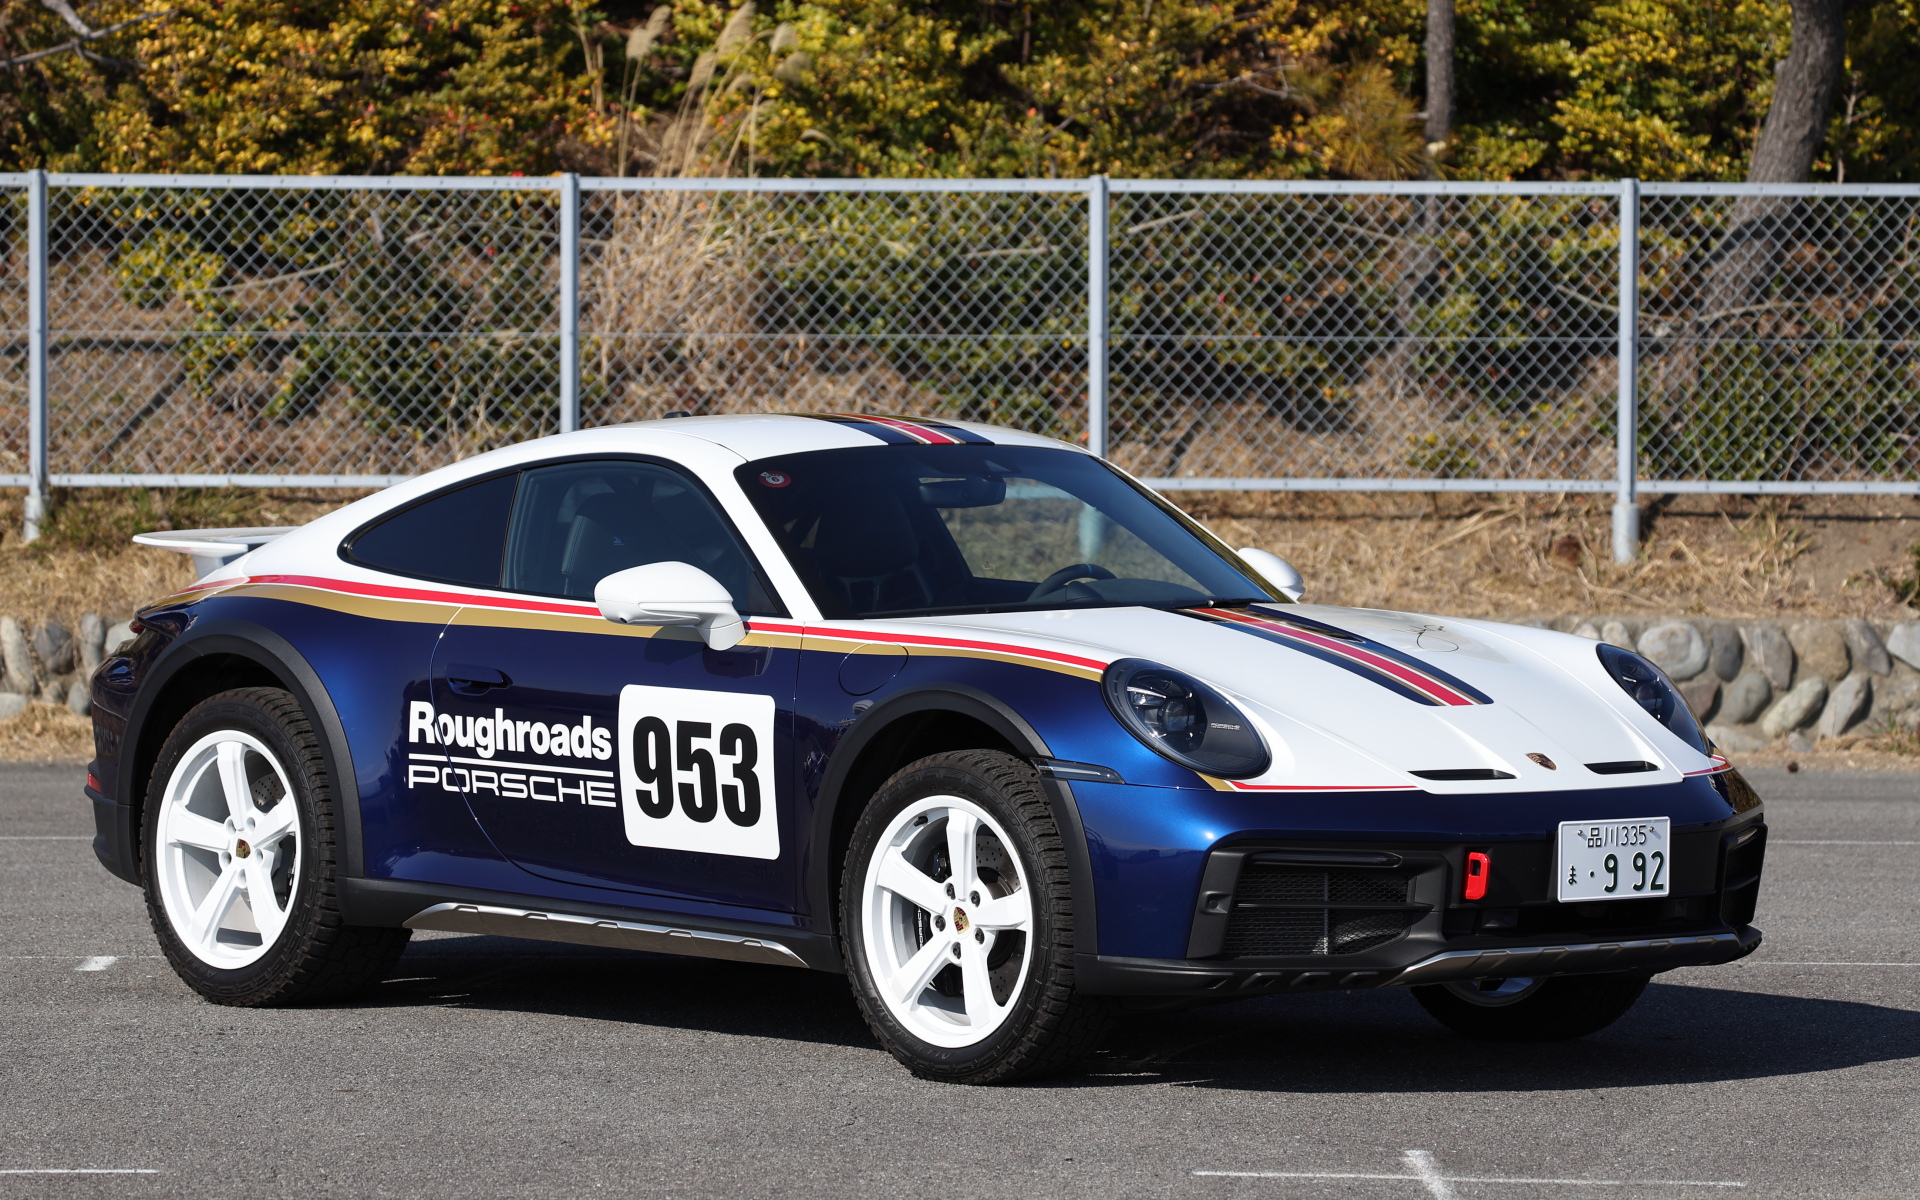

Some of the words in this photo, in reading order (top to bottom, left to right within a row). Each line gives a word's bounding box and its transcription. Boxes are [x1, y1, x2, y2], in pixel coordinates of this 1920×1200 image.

[409, 701, 612, 760] Roughroads
[409, 765, 616, 807] PORSCHE
[633, 716, 762, 827] 953
